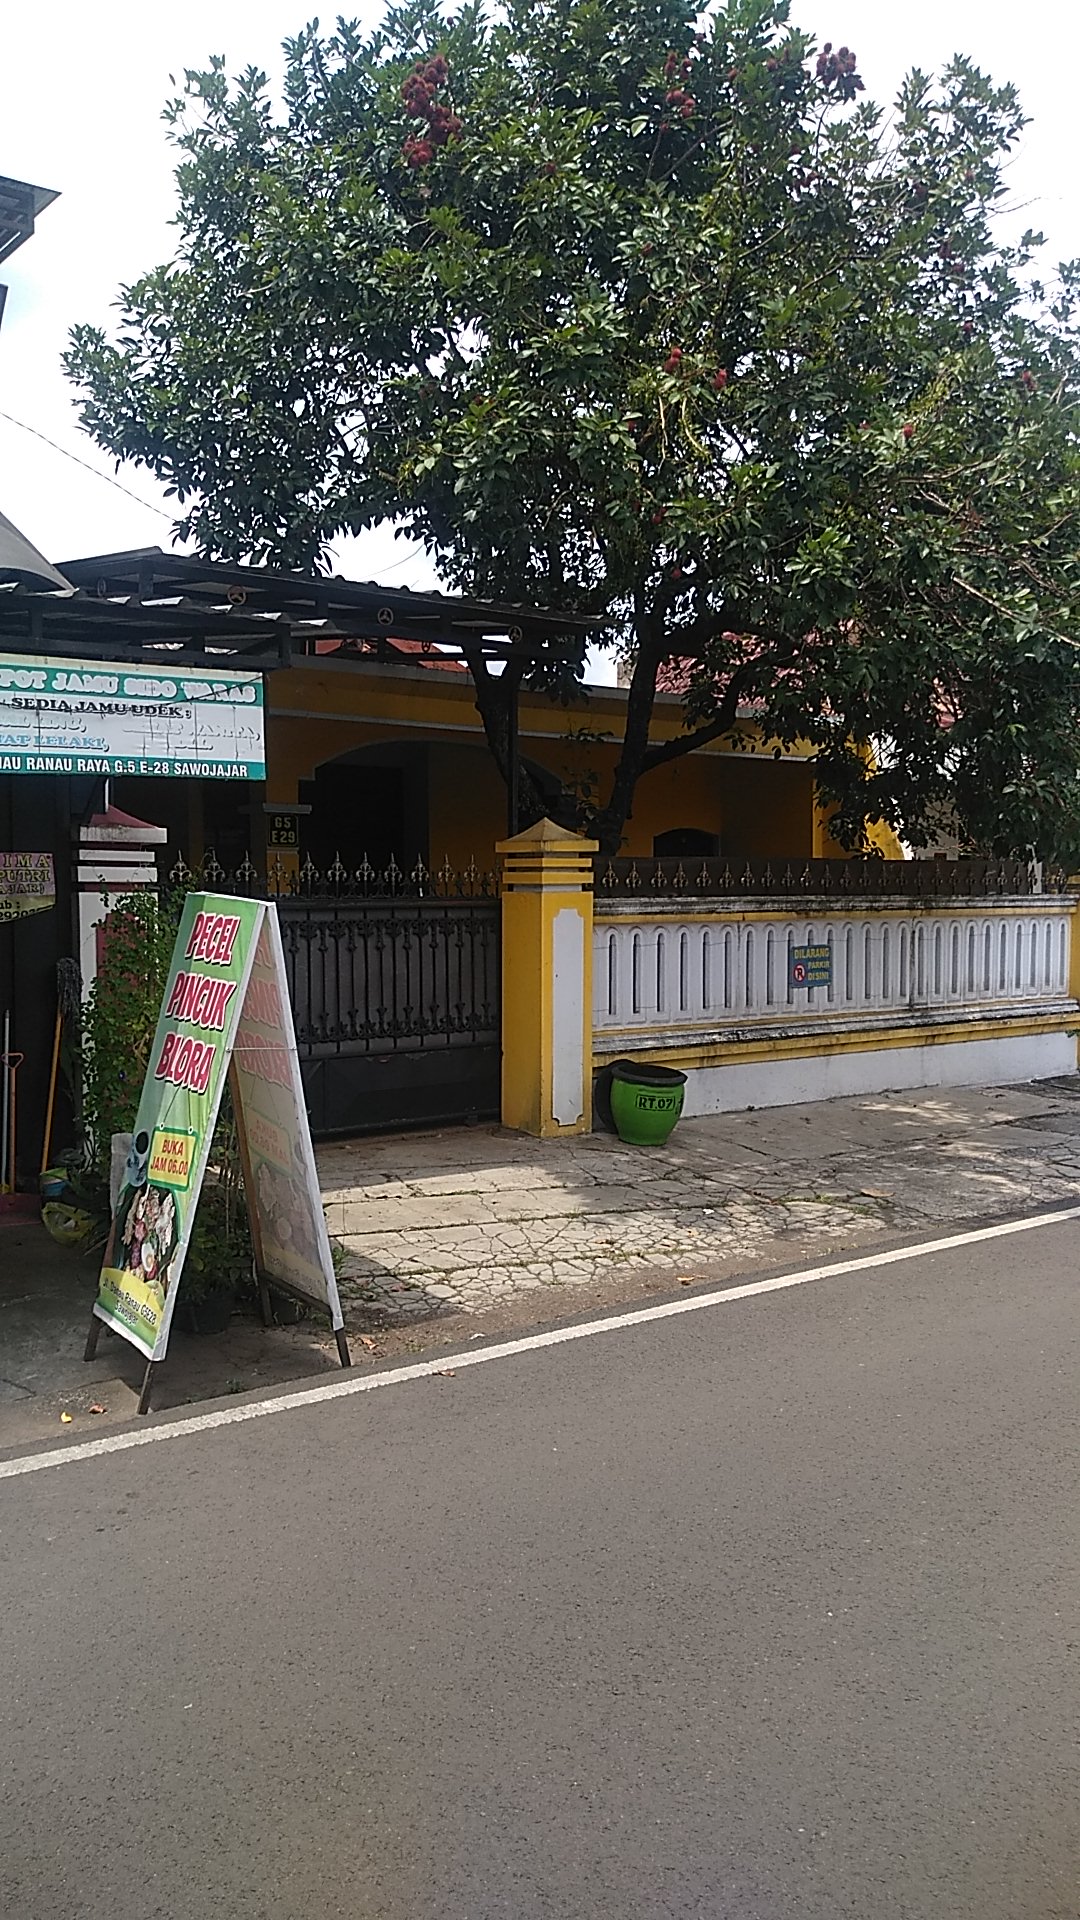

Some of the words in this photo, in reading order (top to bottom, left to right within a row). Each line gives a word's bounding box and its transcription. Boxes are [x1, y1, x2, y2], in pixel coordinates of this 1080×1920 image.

[52, 672, 119, 694] JAMU
[11, 697, 72, 712] SEDIA
[73, 701, 127, 715] JAMU
[26, 757, 72, 771] RANAU
[77, 758, 110, 772] RAYA
[114, 760, 136, 773] G.5
[139, 761, 170, 774] E-28
[174, 763, 248, 777] SAWOJAJAR
[271, 830, 295, 843] E29
[185, 912, 241, 966] PECEL
[795, 948, 829, 959] DILARANG
[808, 961, 829, 969] PARKIR
[165, 971, 237, 1031] PINCUK
[155, 1032, 215, 1094] BLORA
[638, 1097, 673, 1109] RT.07
[162, 1139, 184, 1156] BUKA
[151, 1156, 167, 1172] JAM
[167, 1158, 188, 1176] 06.00
